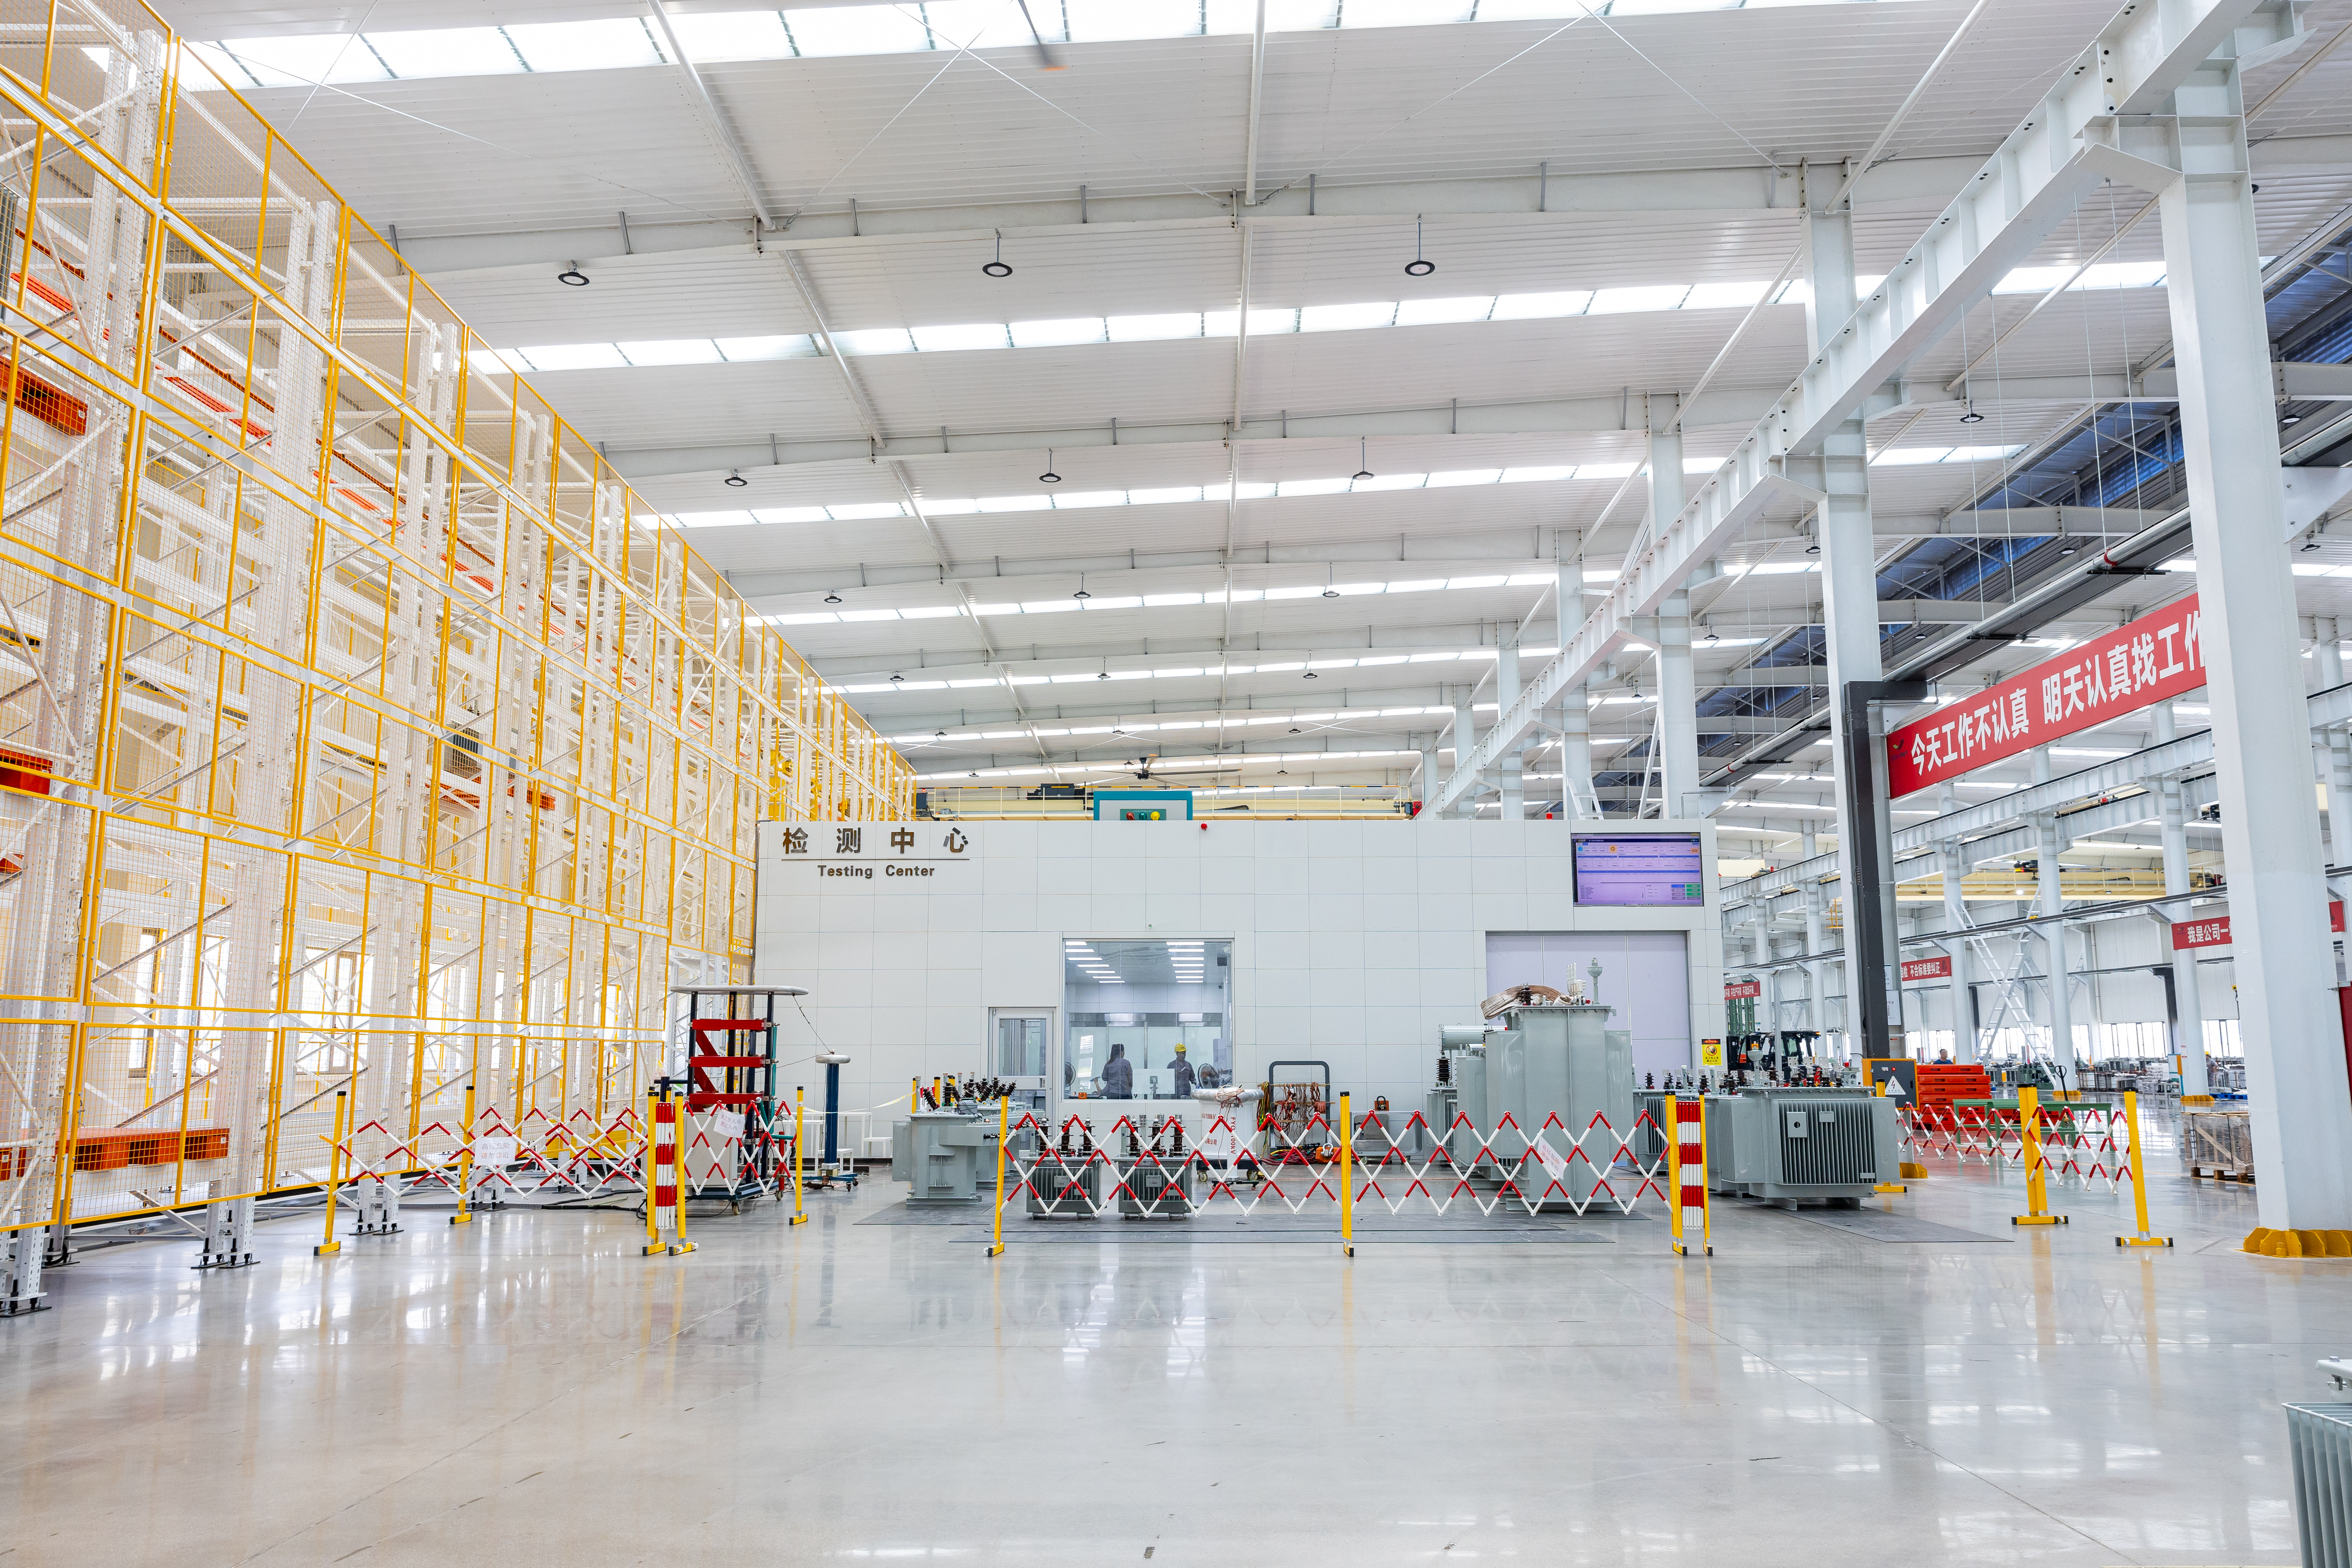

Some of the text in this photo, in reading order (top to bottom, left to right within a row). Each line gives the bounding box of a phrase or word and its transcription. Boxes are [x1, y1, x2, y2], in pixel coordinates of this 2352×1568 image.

[1911, 610, 2206, 776] 今天工作不认真 明天认真找工作
[782, 827, 969, 854] 检测中心
[817, 865, 935, 879] Testing Center
[2187, 921, 2232, 943] 我是公司一
[1910, 962, 1941, 977] 不合标准要纠正
[720, 1121, 738, 1131] 禁止入内
